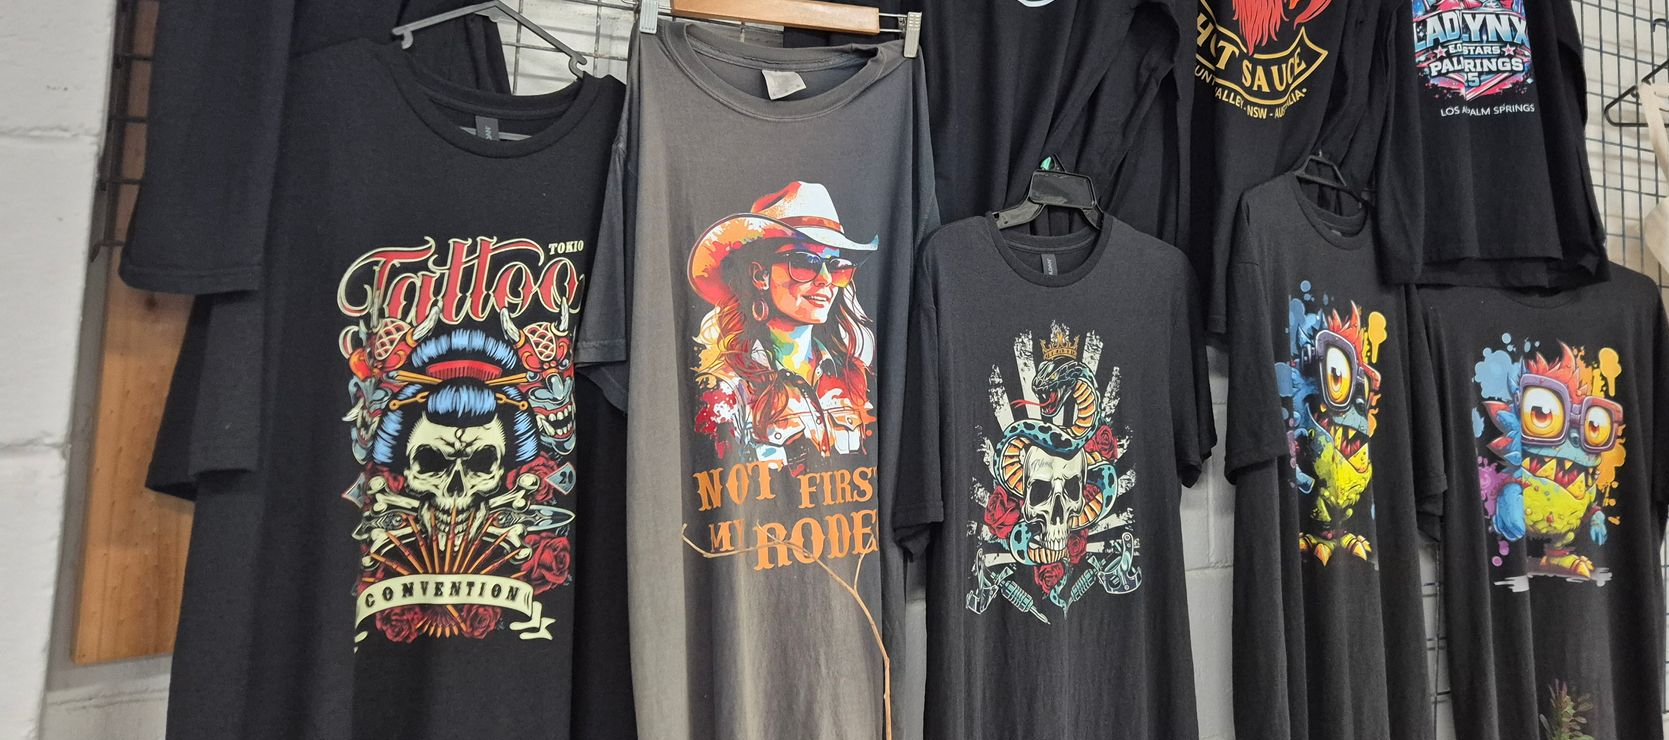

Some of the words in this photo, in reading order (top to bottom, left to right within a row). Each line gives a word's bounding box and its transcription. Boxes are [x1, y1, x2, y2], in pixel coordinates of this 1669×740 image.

[1242, 47, 1307, 93] SAUCE
[1464, 58, 1524, 72] RINGS
[1215, 87, 1244, 110] ALLEY
[1247, 106, 1267, 119] NSW
[1440, 106, 1460, 117] LOS
[1493, 103, 1535, 115] SPRINGS
[548, 240, 584, 255] TOKIO
[693, 459, 784, 512] NOT
[797, 466, 877, 509] FIRS
[754, 509, 879, 571] RODE
[365, 580, 519, 608] CONVENTION
